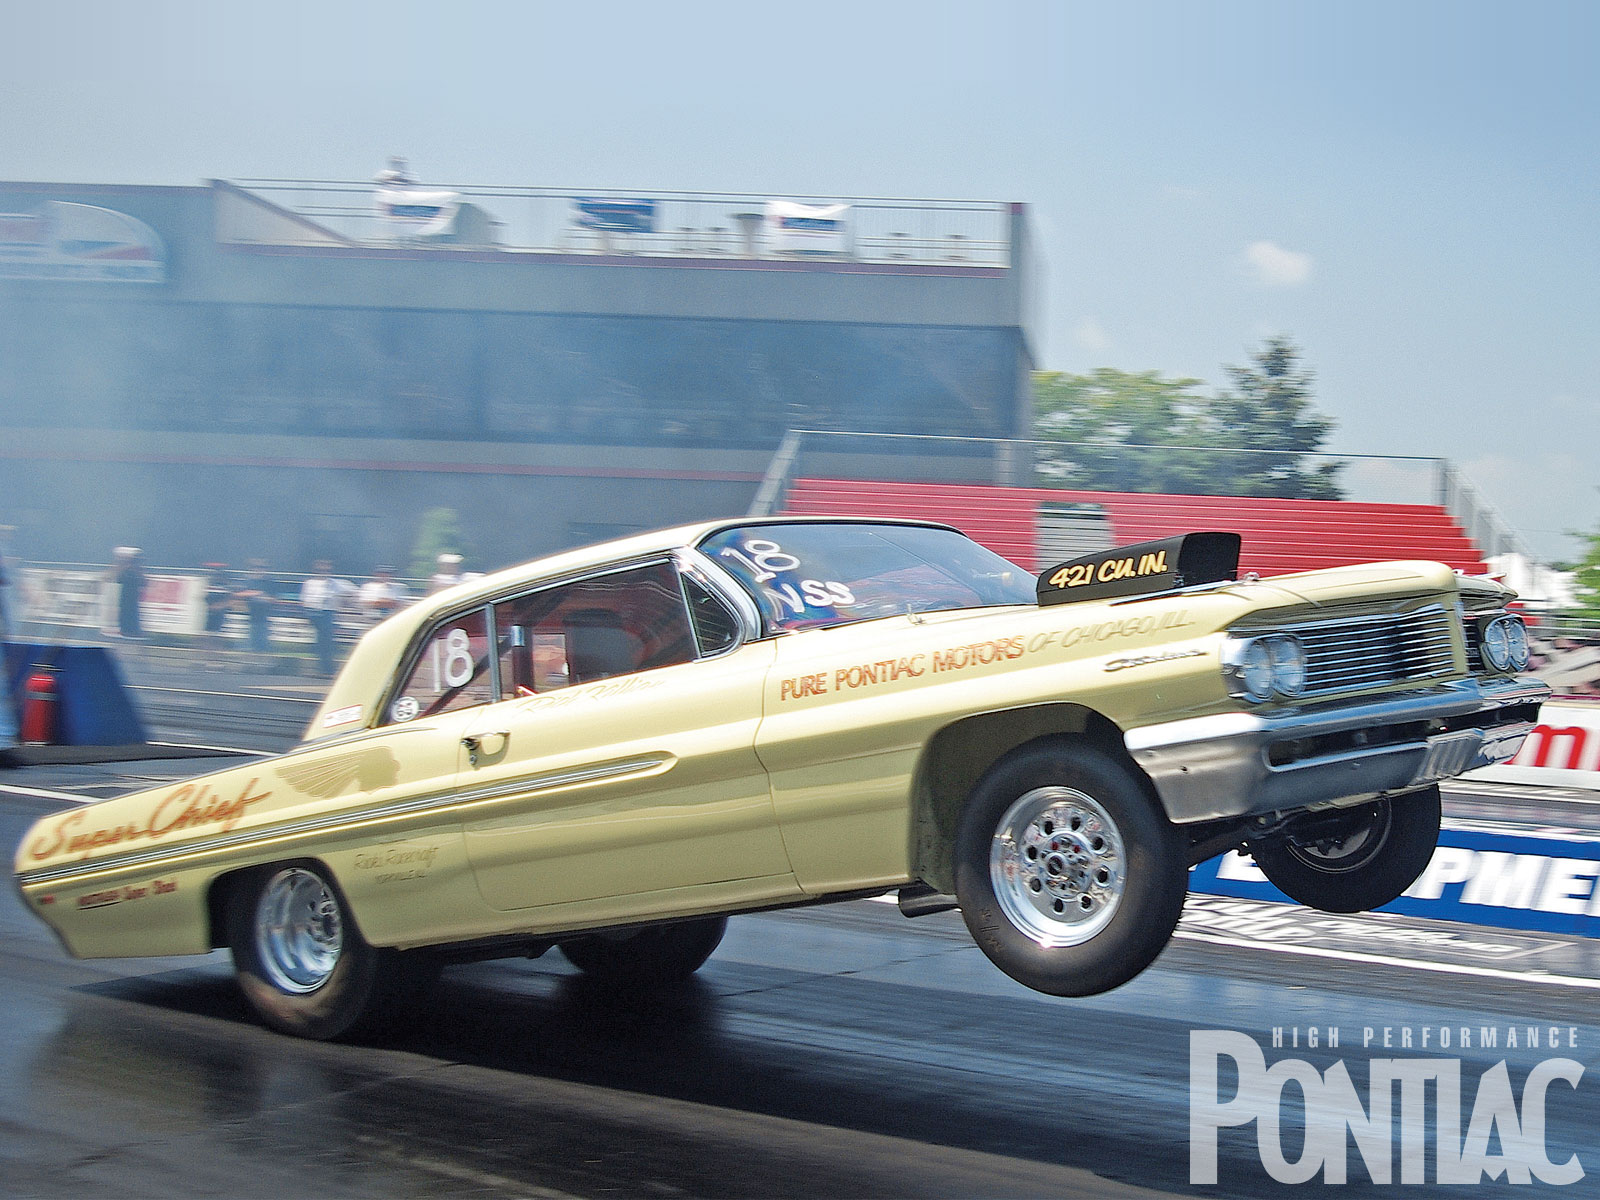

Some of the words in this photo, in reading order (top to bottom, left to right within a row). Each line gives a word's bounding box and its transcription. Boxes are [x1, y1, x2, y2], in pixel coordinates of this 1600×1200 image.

[721, 539, 801, 583] 18
[1048, 564, 1094, 588] 421
[763, 580, 856, 621] NSS
[433, 628, 474, 693] 18
[780, 672, 828, 701] PURE
[834, 653, 925, 691] PONTIAC
[932, 635, 1025, 673] MOTORS
[1027, 630, 1062, 653] OF
[31, 810, 148, 860] Super
[149, 777, 273, 838] Chief
